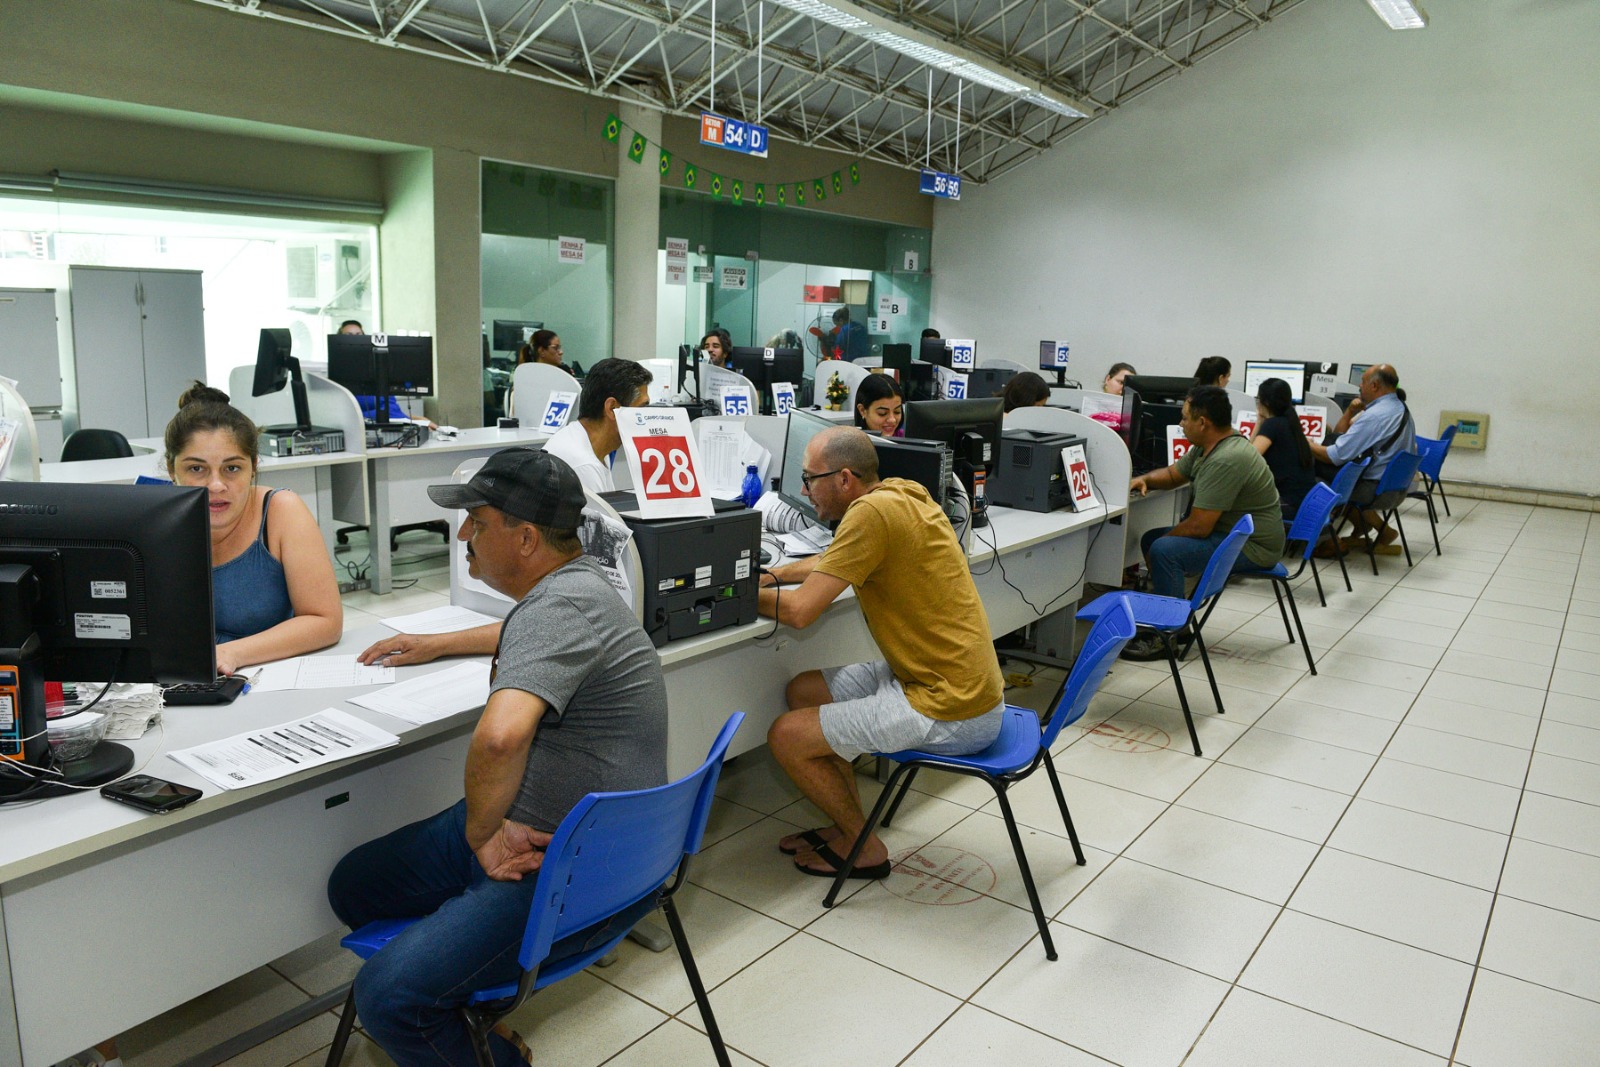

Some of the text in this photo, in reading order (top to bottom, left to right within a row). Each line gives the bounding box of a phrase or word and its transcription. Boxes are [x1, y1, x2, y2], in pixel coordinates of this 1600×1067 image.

[705, 117, 721, 128] SETOR
[708, 127, 717, 140] M
[726, 123, 743, 146] 54
[751, 130, 761, 148] D
[934, 176, 959, 197] 56 59
[909, 259, 914, 270] B
[892, 304, 899, 314] B
[881, 320, 886, 330] B
[374, 334, 385, 344] M
[954, 349, 970, 362] 58
[948, 384, 964, 398] 57
[726, 400, 748, 416] 55
[778, 396, 792, 413] 56
[546, 406, 568, 426] 54
[1300, 418, 1322, 436] 32
[641, 447, 695, 494] 28
[1072, 468, 1089, 496] 29
